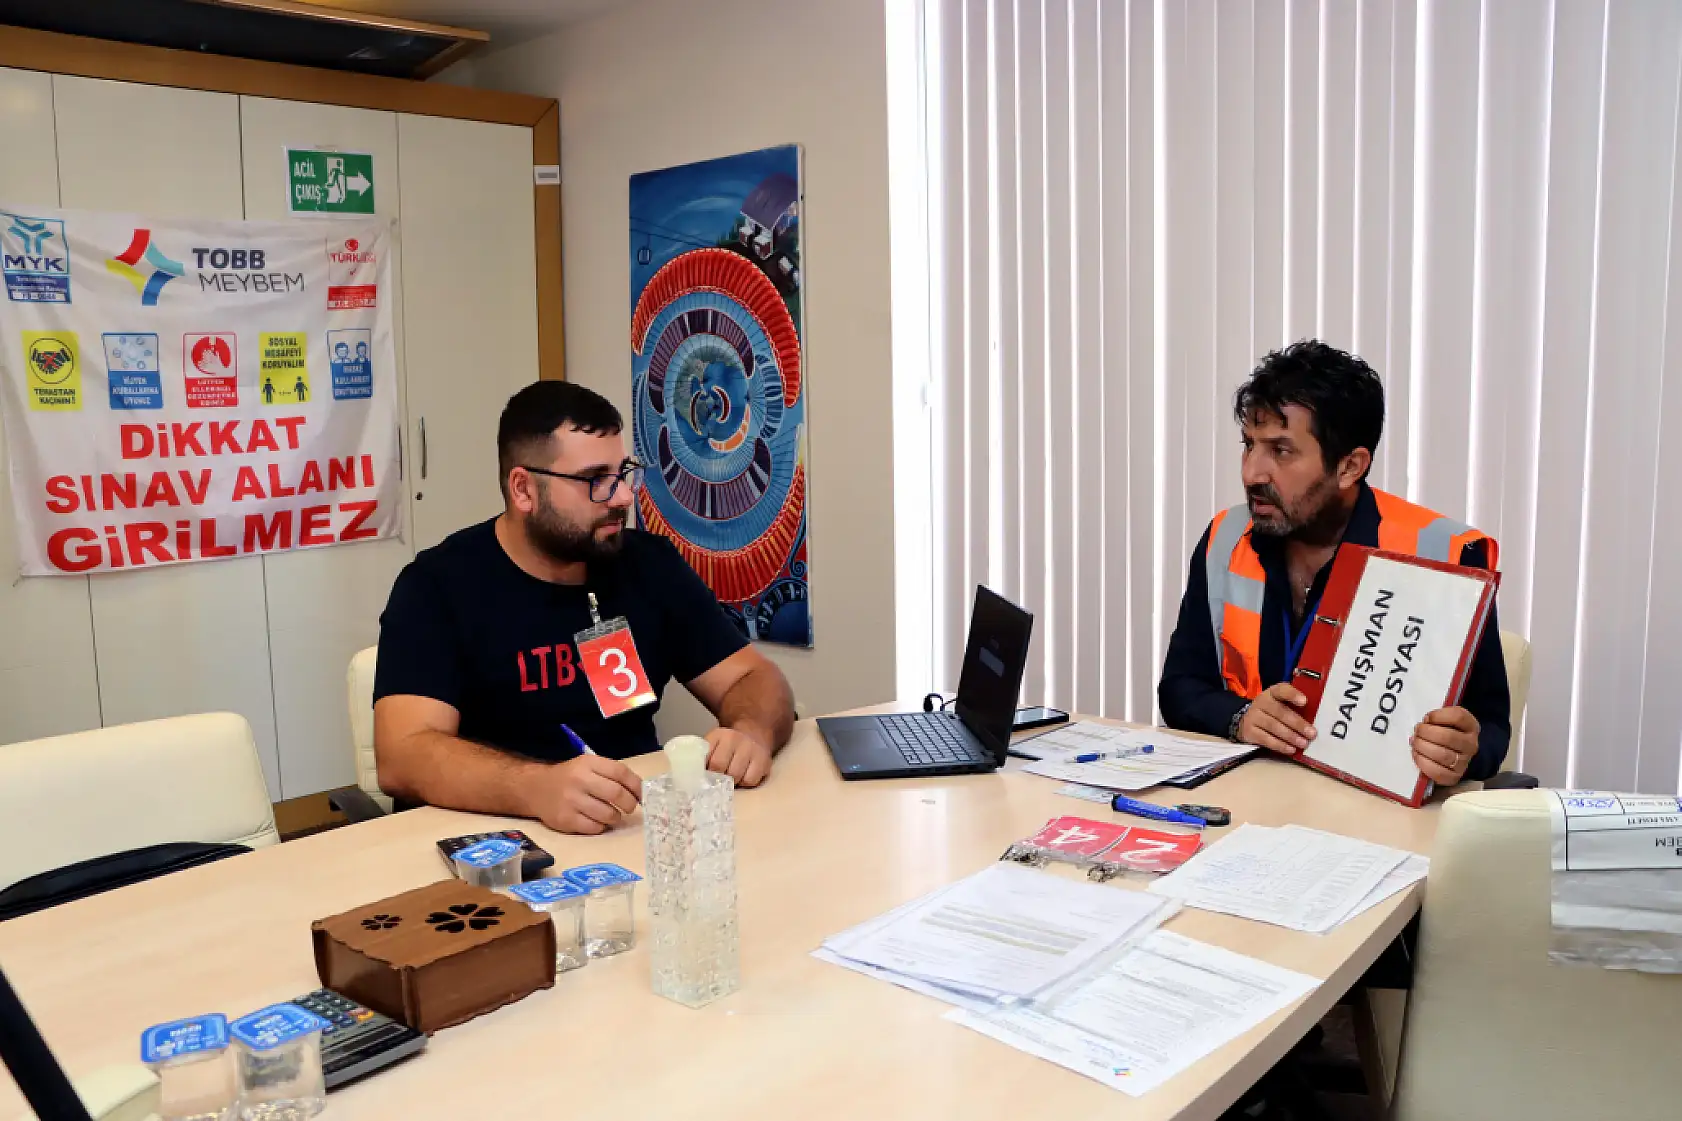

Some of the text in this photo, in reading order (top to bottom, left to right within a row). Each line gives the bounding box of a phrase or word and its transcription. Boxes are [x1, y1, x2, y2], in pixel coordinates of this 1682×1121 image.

[4, 254, 65, 272] MYK
[192, 247, 266, 269] TOBB
[198, 272, 305, 292] MEYBEM
[268, 336, 298, 347] SOSYAL
[45, 453, 375, 514] SINAV ALANI
[599, 648, 638, 697] 3
[1330, 588, 1395, 740] DANIŞMAN
[1370, 615, 1425, 735] DOSYASI
[1047, 825, 1101, 845] 4
[1119, 837, 1178, 864] 2
